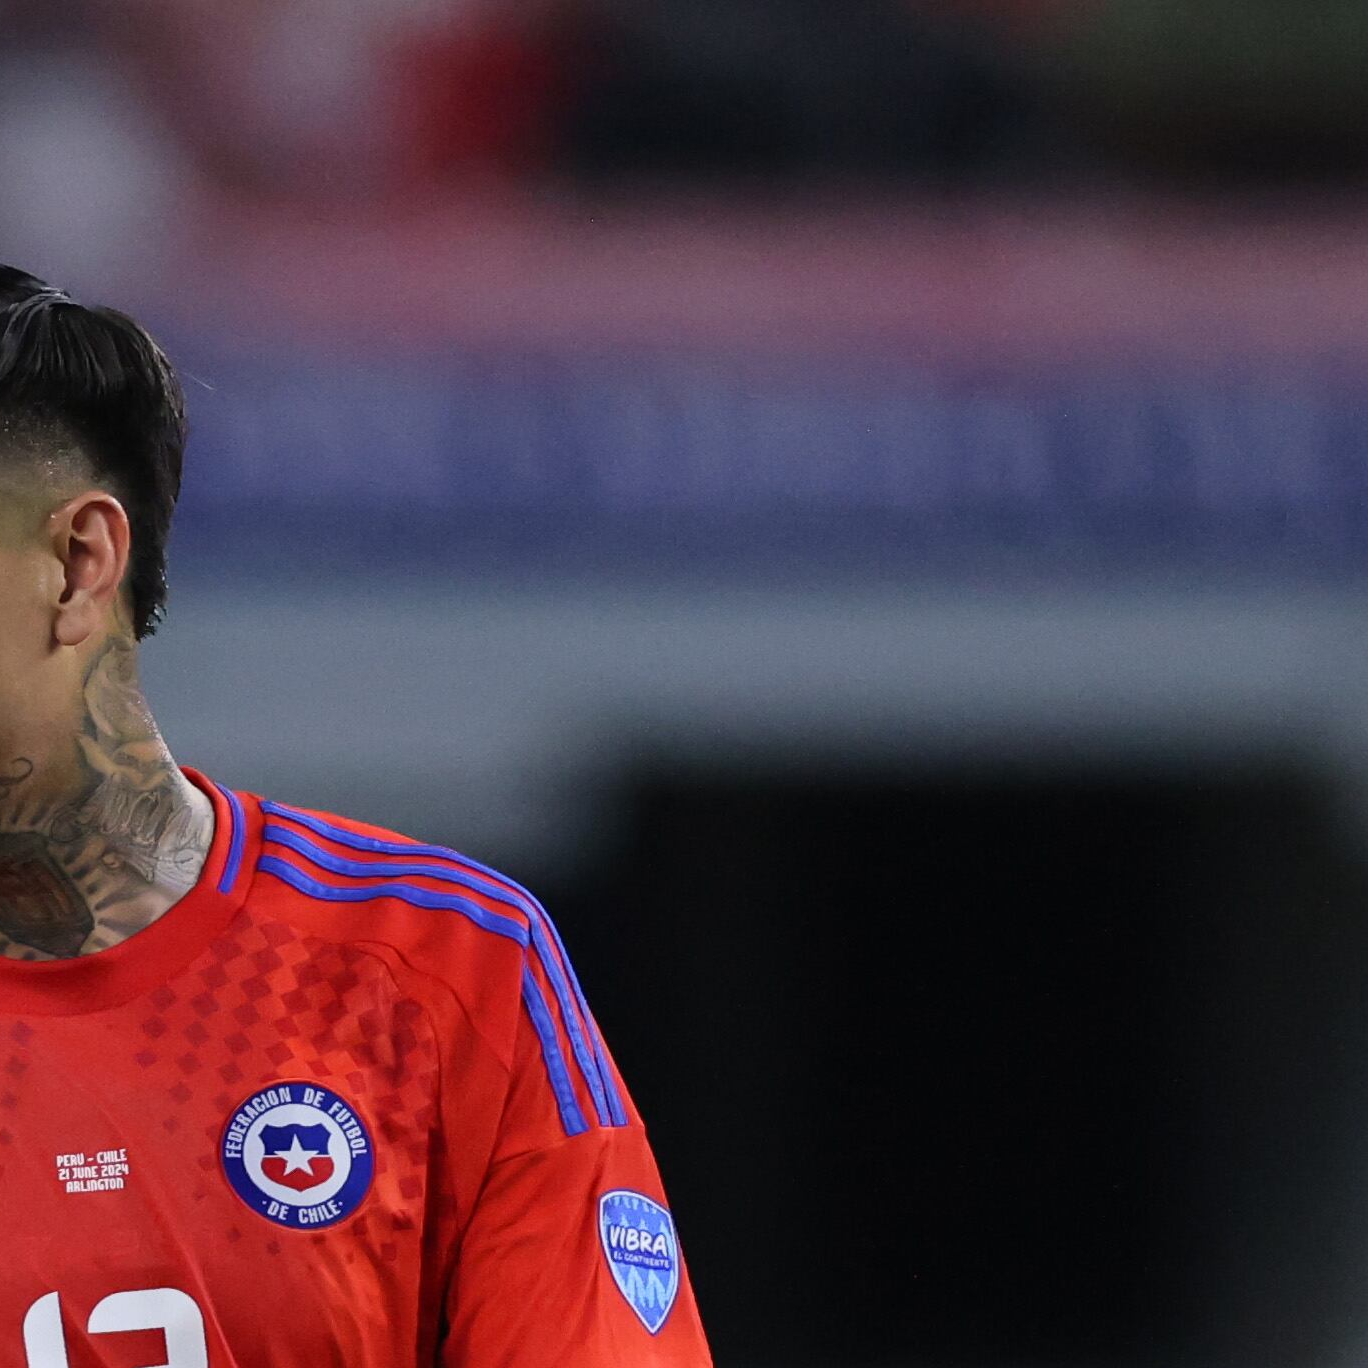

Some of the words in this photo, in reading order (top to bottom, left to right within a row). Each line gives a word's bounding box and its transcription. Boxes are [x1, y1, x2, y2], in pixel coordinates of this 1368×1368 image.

[226, 1087, 291, 1158] FEDERACION
[303, 1088, 325, 1107] DE
[328, 1101, 367, 1158] FUTBOL
[56, 1153, 85, 1168] PERU
[96, 1148, 127, 1164] CHILE
[58, 1168, 70, 1180] 21
[72, 1166, 99, 1179] JUNE
[100, 1163, 129, 1177] 2024
[66, 1178, 124, 1193] ARLINGTON
[267, 1202, 289, 1220] DE
[298, 1200, 341, 1223] CHILE
[609, 1225, 667, 1256] VIBRA
